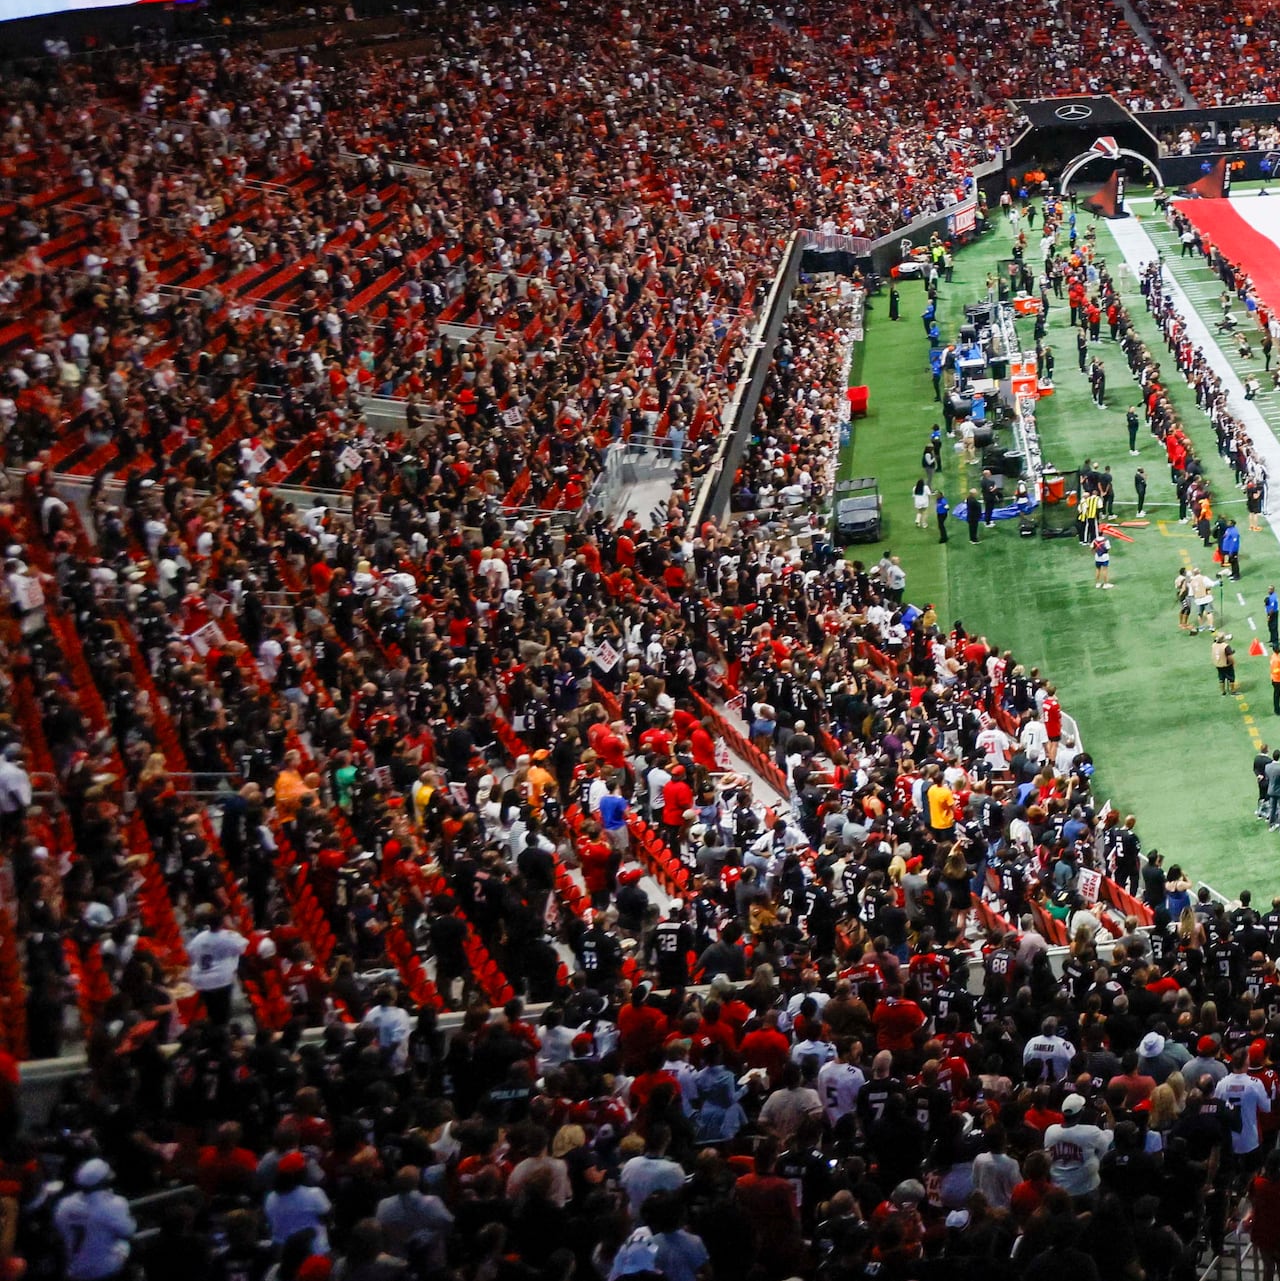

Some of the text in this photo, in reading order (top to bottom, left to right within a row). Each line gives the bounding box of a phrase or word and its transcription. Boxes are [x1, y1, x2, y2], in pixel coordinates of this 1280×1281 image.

[776, 681, 783, 697] 7
[910, 729, 920, 746] 7
[1028, 733, 1035, 745] 7
[983, 742, 996, 754] 21
[1055, 824, 1063, 839] 7
[845, 879, 855, 896] 9
[805, 898, 814, 915] 7
[867, 904, 876, 920] 9
[657, 933, 678, 952] 32
[992, 958, 1008, 974] 88
[1219, 960, 1230, 977] 9
[1033, 1043, 1055, 1053] SANDERS
[826, 1086, 839, 1108] 5
[872, 1103, 887, 1122] 7
